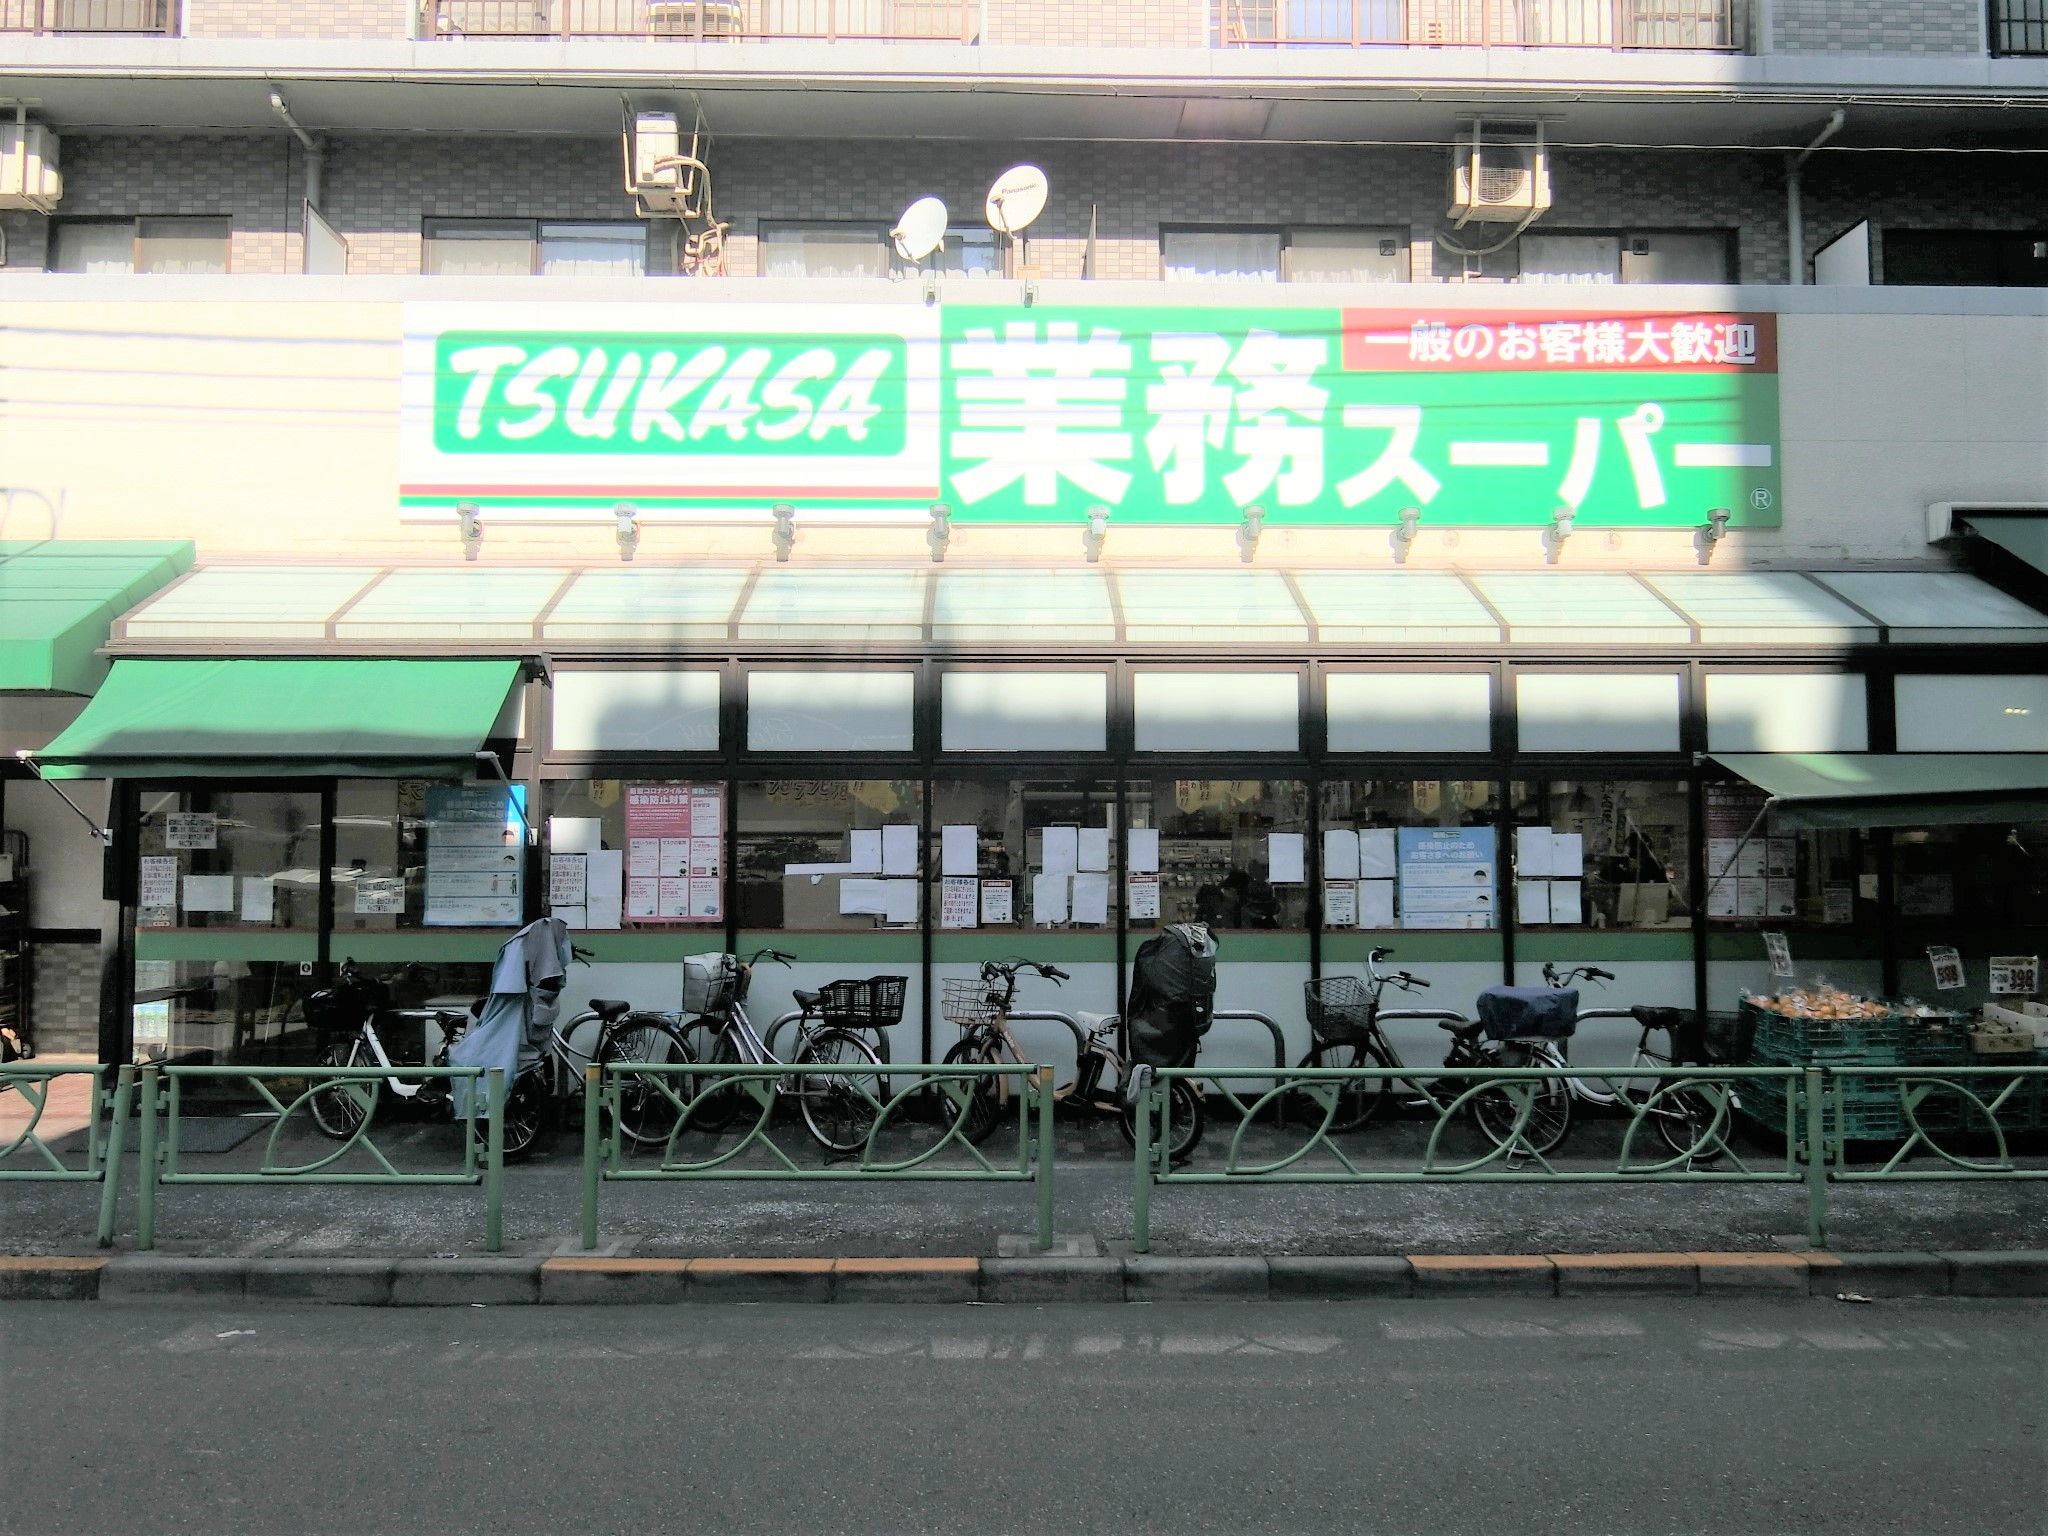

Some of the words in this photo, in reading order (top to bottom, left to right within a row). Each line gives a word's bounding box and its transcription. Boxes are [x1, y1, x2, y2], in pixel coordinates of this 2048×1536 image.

[1001, 182, 1037, 195] Panasonic
[1365, 320, 1757, 366] 一般のお客様大歓迎
[449, 344, 894, 442] TSUKASA
[948, 320, 1772, 509] 業務スーパー
[629, 795, 689, 805] 感染防止対策
